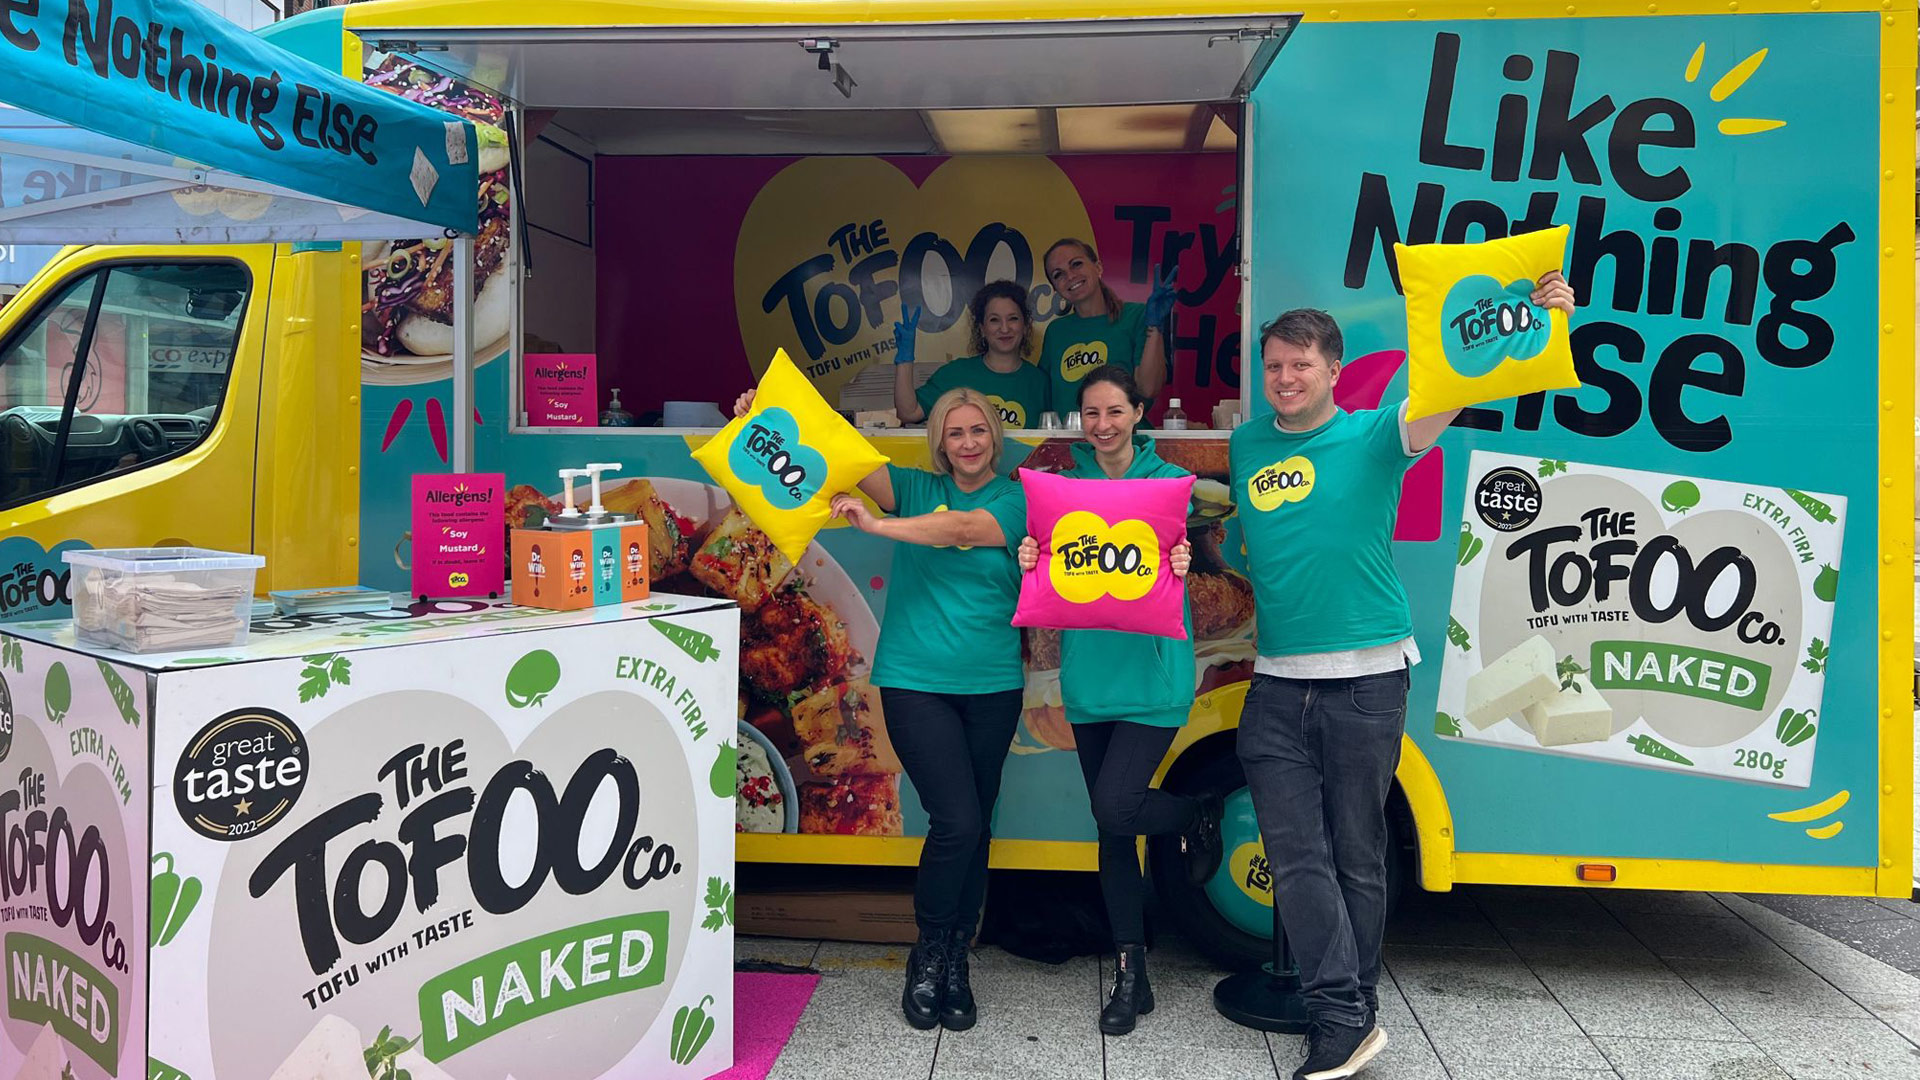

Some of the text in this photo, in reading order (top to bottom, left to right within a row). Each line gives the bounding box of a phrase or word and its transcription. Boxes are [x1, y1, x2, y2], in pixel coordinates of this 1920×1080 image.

[62, 0, 285, 151] Nothing
[292, 83, 379, 166] Else
[1419, 31, 1697, 203] Like
[828, 219, 890, 264] THE
[1114, 205, 1237, 307] Try
[1474, 298, 1494, 312] THE
[534, 366, 587, 382] Allergens!
[807, 339, 897, 378] TOFU WITH TAS
[546, 413, 577, 421] Mustard
[554, 401, 568, 409] Soy
[770, 430, 785, 446] THE
[426, 488, 493, 506] Allergens!
[1479, 489, 1538, 513] taste
[1494, 480, 1526, 492] great
[450, 530, 468, 539] Soy
[1078, 534, 1098, 546] THE
[1581, 507, 1636, 541] THE
[1743, 493, 1815, 564] EXTRA FIRM
[440, 544, 478, 552] Mustard
[531, 552, 542, 562] Dr.
[573, 554, 582, 562] Dr.
[13, 562, 35, 578] THE
[1527, 611, 1629, 629] TOFU WITH TASTE
[1737, 611, 1786, 646] Co.
[1604, 651, 1757, 697] NAKED
[616, 656, 708, 742] EXTRA FIRM
[212, 732, 275, 766] great
[1733, 749, 1787, 779] 280g
[70, 728, 132, 806] EXTRA FIRM
[183, 756, 301, 803] taste
[377, 738, 468, 810] THE
[19, 767, 46, 811] THE
[228, 820, 258, 836] 2022
[622, 836, 682, 890] Co.
[1250, 854, 1261, 868] THE
[1, 905, 48, 922] TOFU WITH TASTE
[102, 920, 129, 974] Co.
[302, 909, 474, 1010] TOFU WITH TASTE
[12, 951, 111, 1044] NAKED
[440, 929, 656, 1042] NAKED
